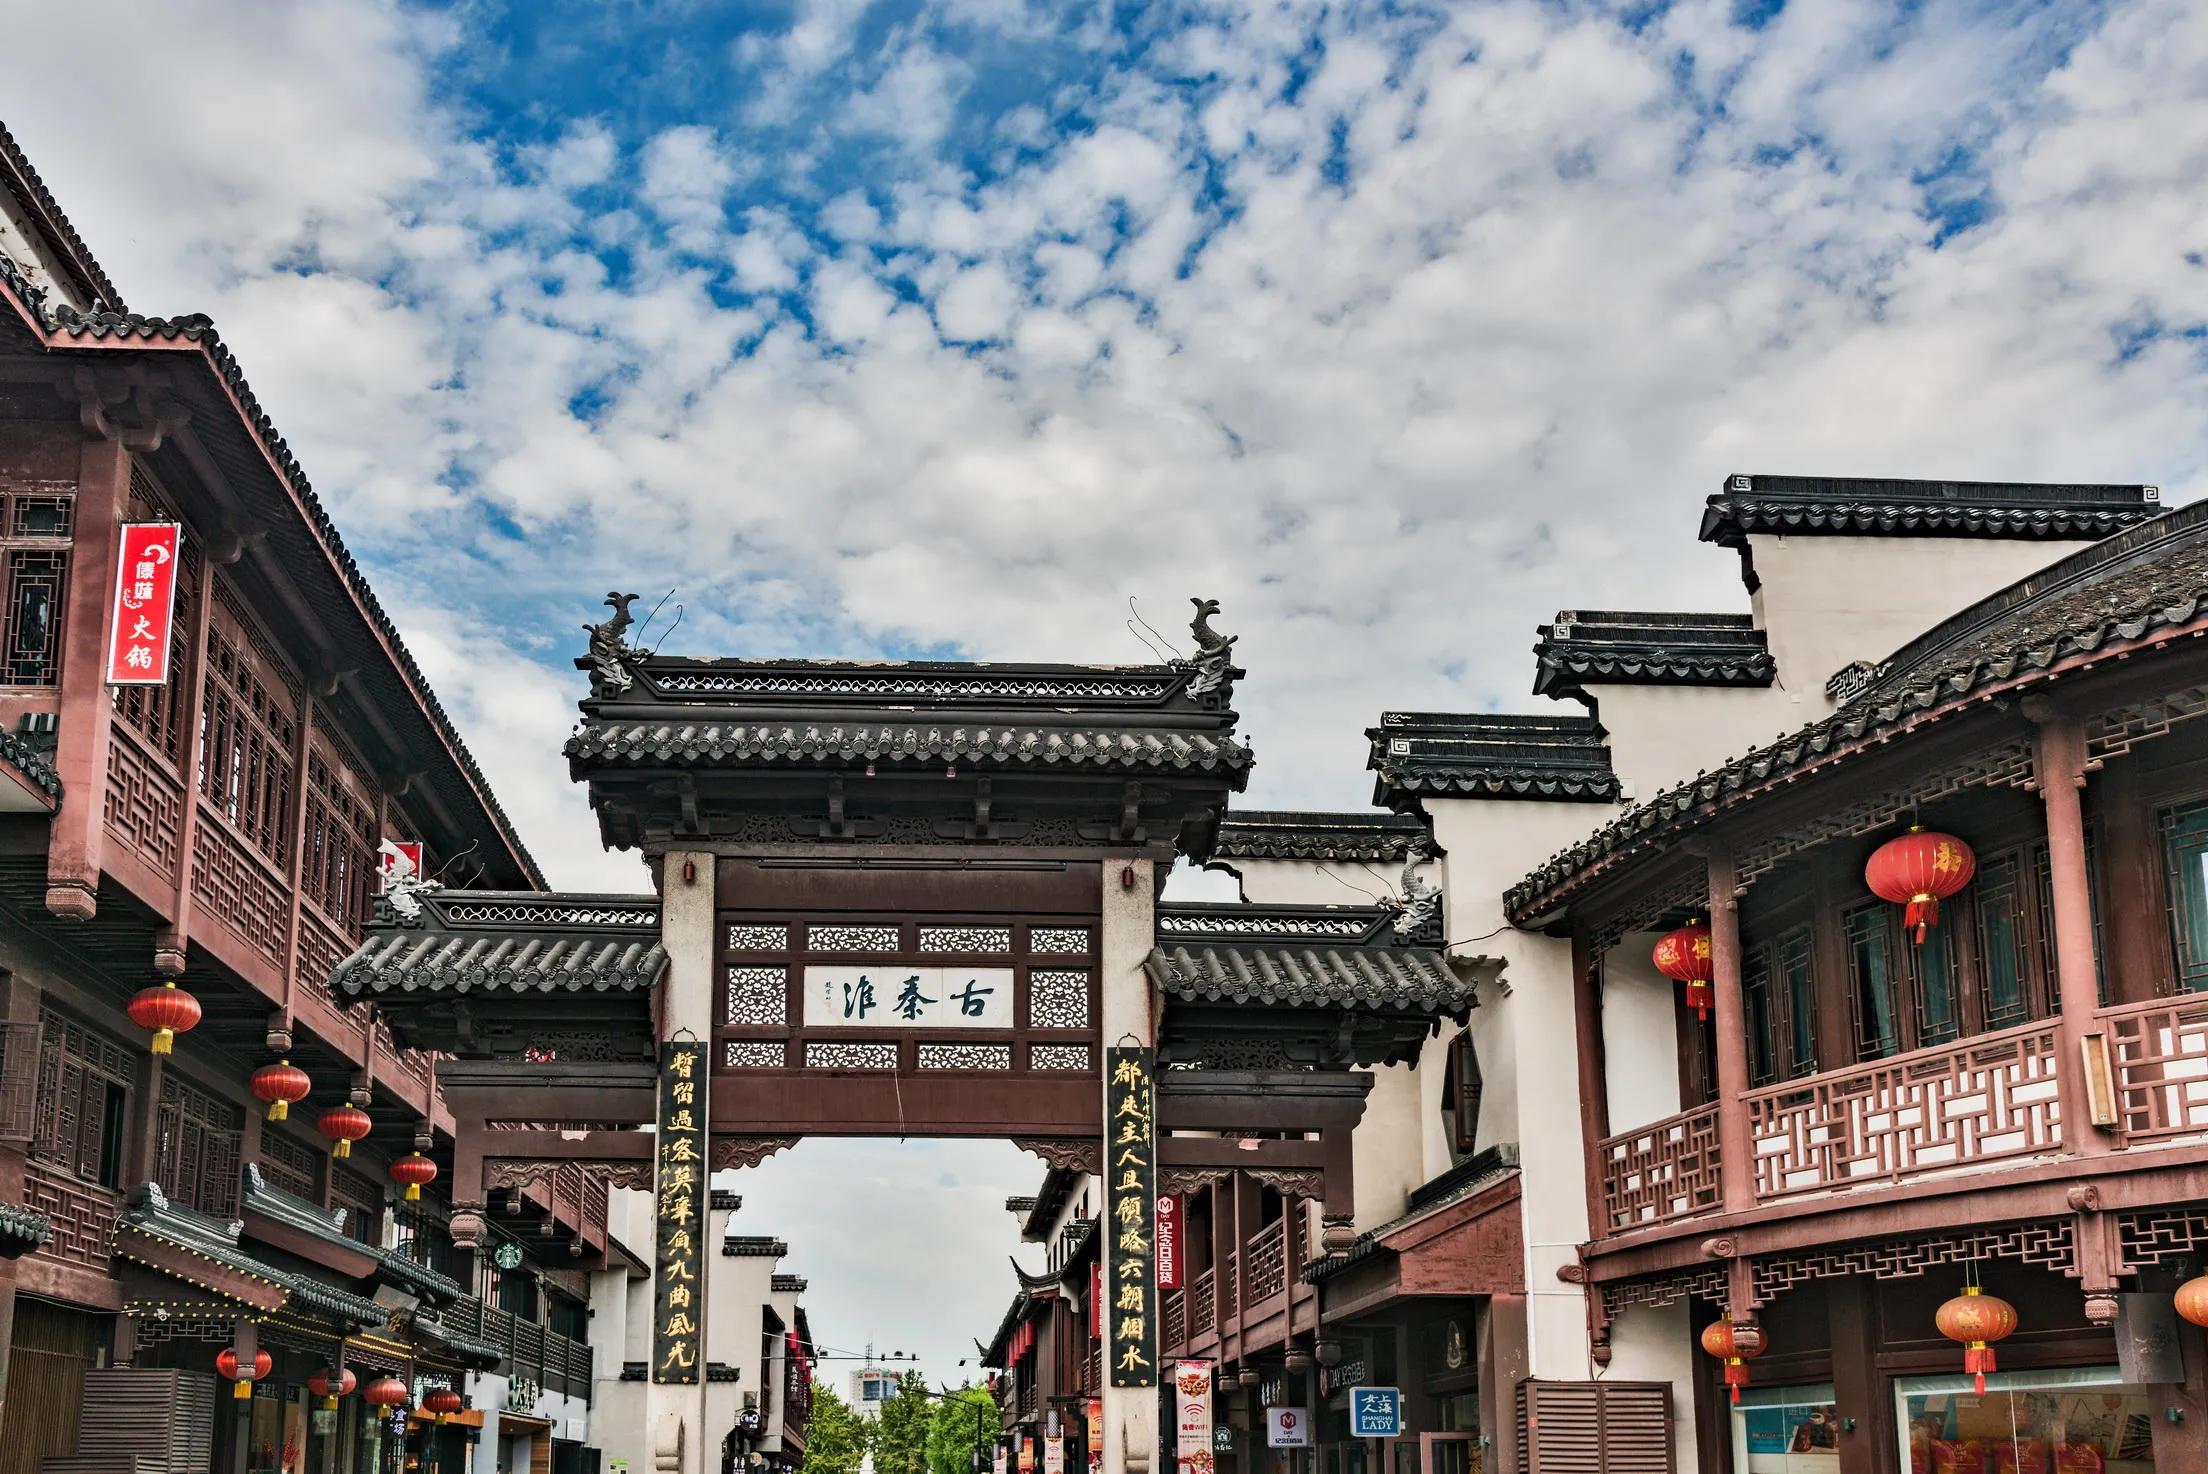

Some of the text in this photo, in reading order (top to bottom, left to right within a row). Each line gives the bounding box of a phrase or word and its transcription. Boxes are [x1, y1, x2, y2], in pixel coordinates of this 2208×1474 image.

[843, 975, 995, 1021] 古秦淮
[1159, 1221, 1173, 1284] 纪念日百货
[1361, 1420, 1393, 1430] LADY
